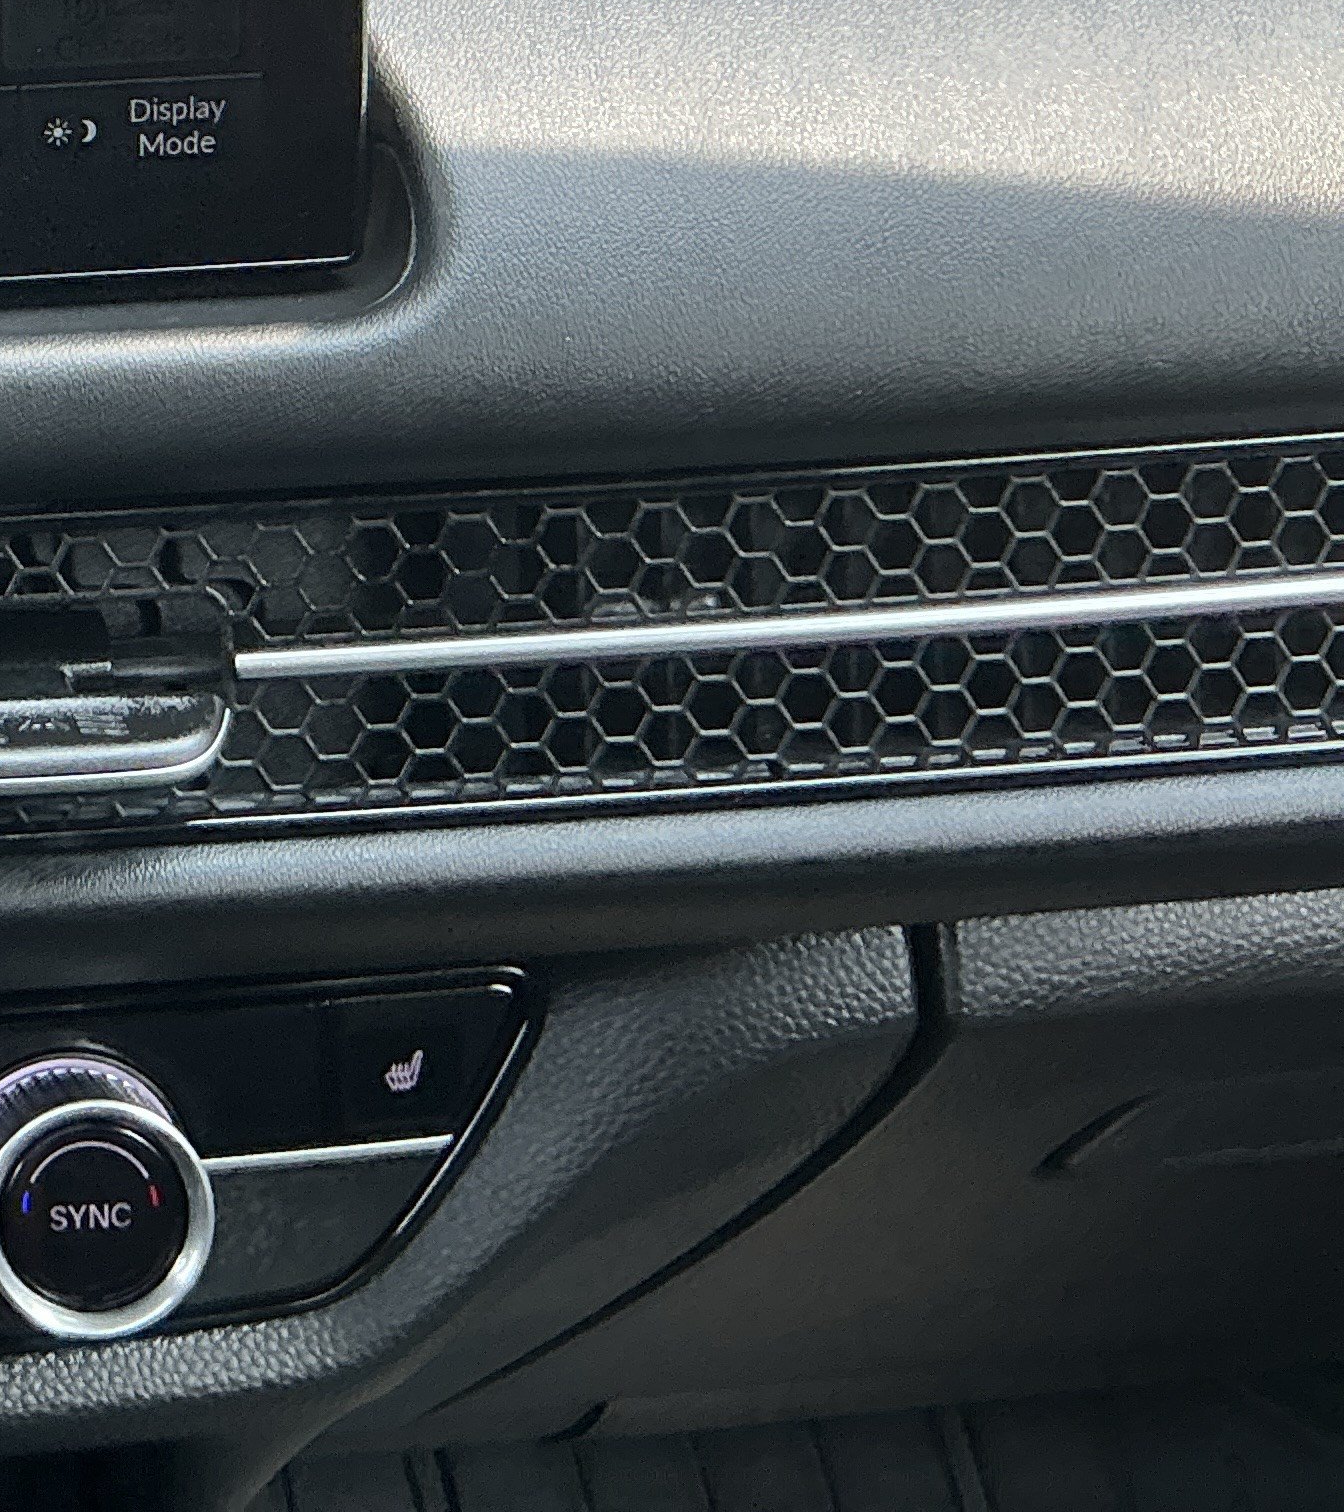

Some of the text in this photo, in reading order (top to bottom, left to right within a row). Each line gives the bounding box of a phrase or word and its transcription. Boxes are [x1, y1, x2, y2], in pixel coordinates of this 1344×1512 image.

[130, 95, 226, 126] Display
[139, 130, 216, 157] Mode
[50, 1202, 131, 1231] SYNC
